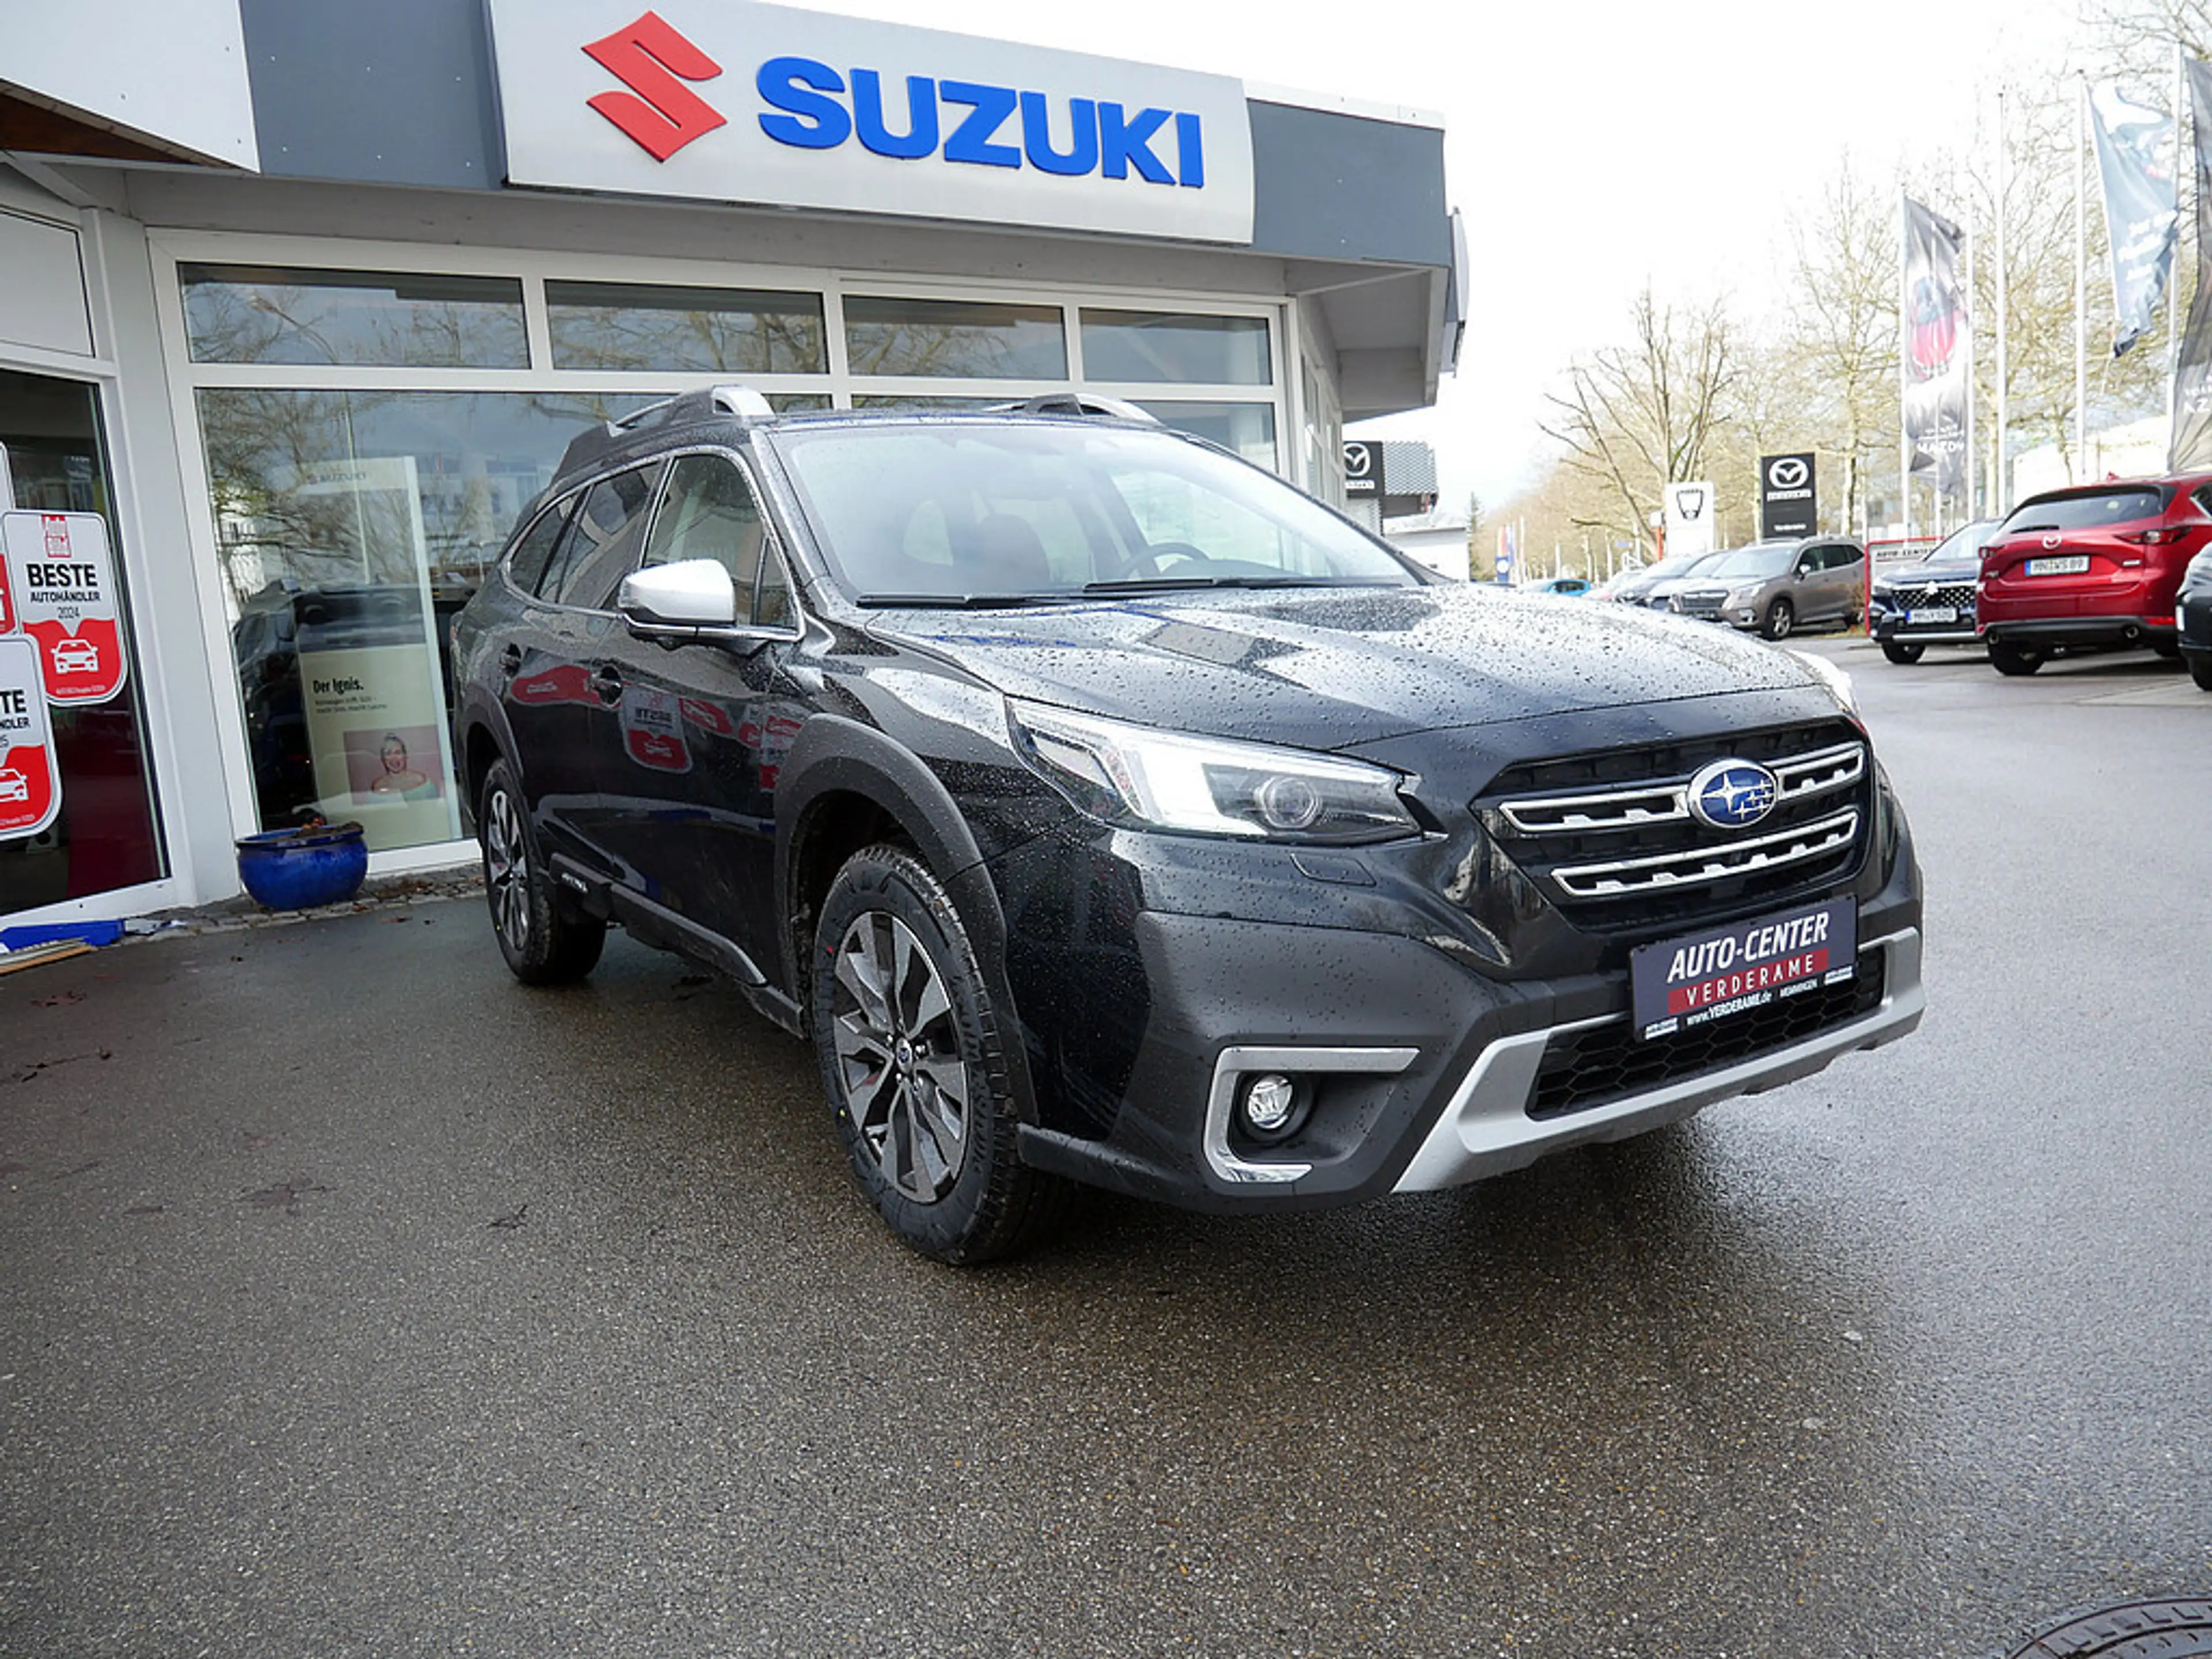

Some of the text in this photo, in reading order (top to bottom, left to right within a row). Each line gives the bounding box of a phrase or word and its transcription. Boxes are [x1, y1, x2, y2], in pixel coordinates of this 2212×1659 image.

[756, 56, 1205, 188] SUZUKI
[26, 563, 98, 587] BESTE
[31, 590, 101, 603] AUTOHÄNDLER
[313, 676, 364, 696] Der Ignis.
[1667, 911, 1829, 983] AUTO-CENTER
[1687, 954, 1814, 1006] VERDERAME
